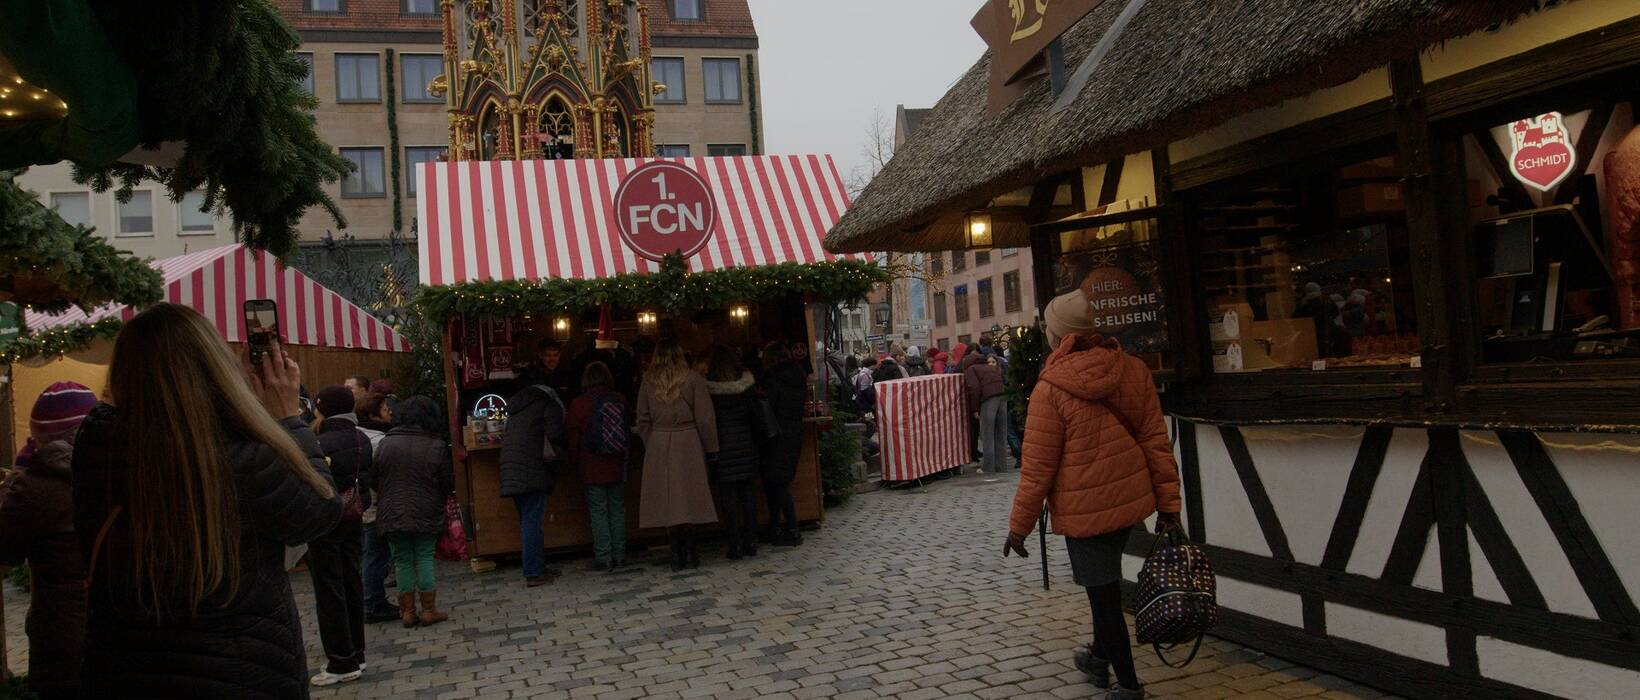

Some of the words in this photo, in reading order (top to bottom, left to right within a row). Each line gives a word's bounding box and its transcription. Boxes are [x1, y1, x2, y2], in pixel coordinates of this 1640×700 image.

[1517, 153, 1567, 170] SCHMIDT
[651, 171, 676, 201] 1.
[628, 202, 705, 235] FCN
[1091, 280, 1124, 294] HIER:
[1090, 292, 1158, 310] NFRISCHE
[1094, 310, 1158, 328] S-ELISEN!
